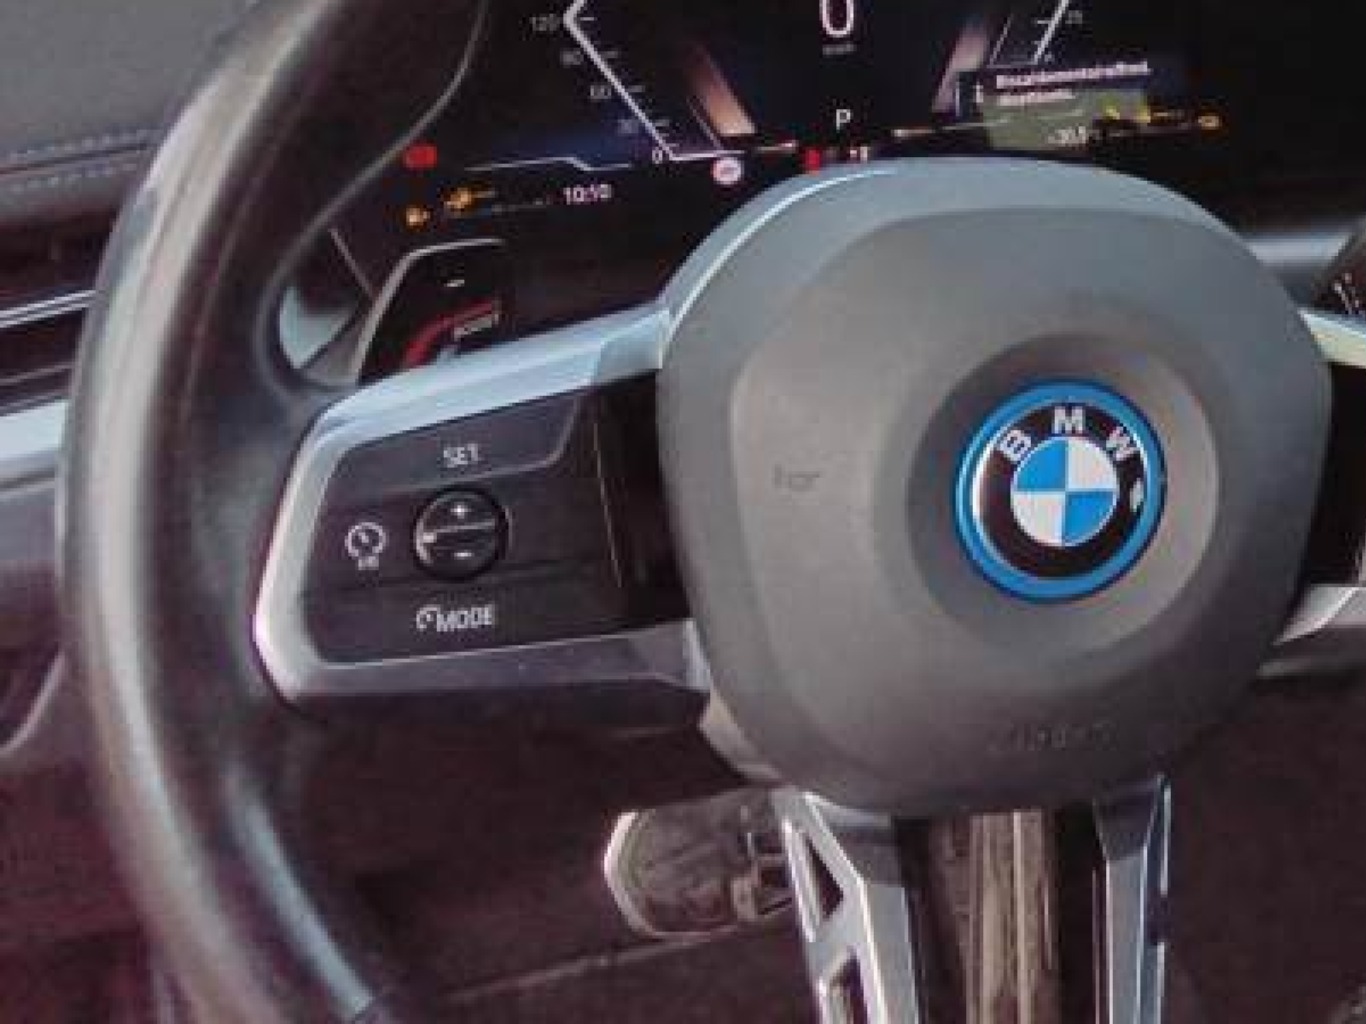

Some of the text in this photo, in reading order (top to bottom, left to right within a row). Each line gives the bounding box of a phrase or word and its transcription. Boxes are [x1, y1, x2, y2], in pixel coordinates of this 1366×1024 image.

[835, 108, 851, 133] P
[998, 405, 1140, 462] BMW
[443, 444, 480, 467] SET
[436, 605, 494, 632] MODE
